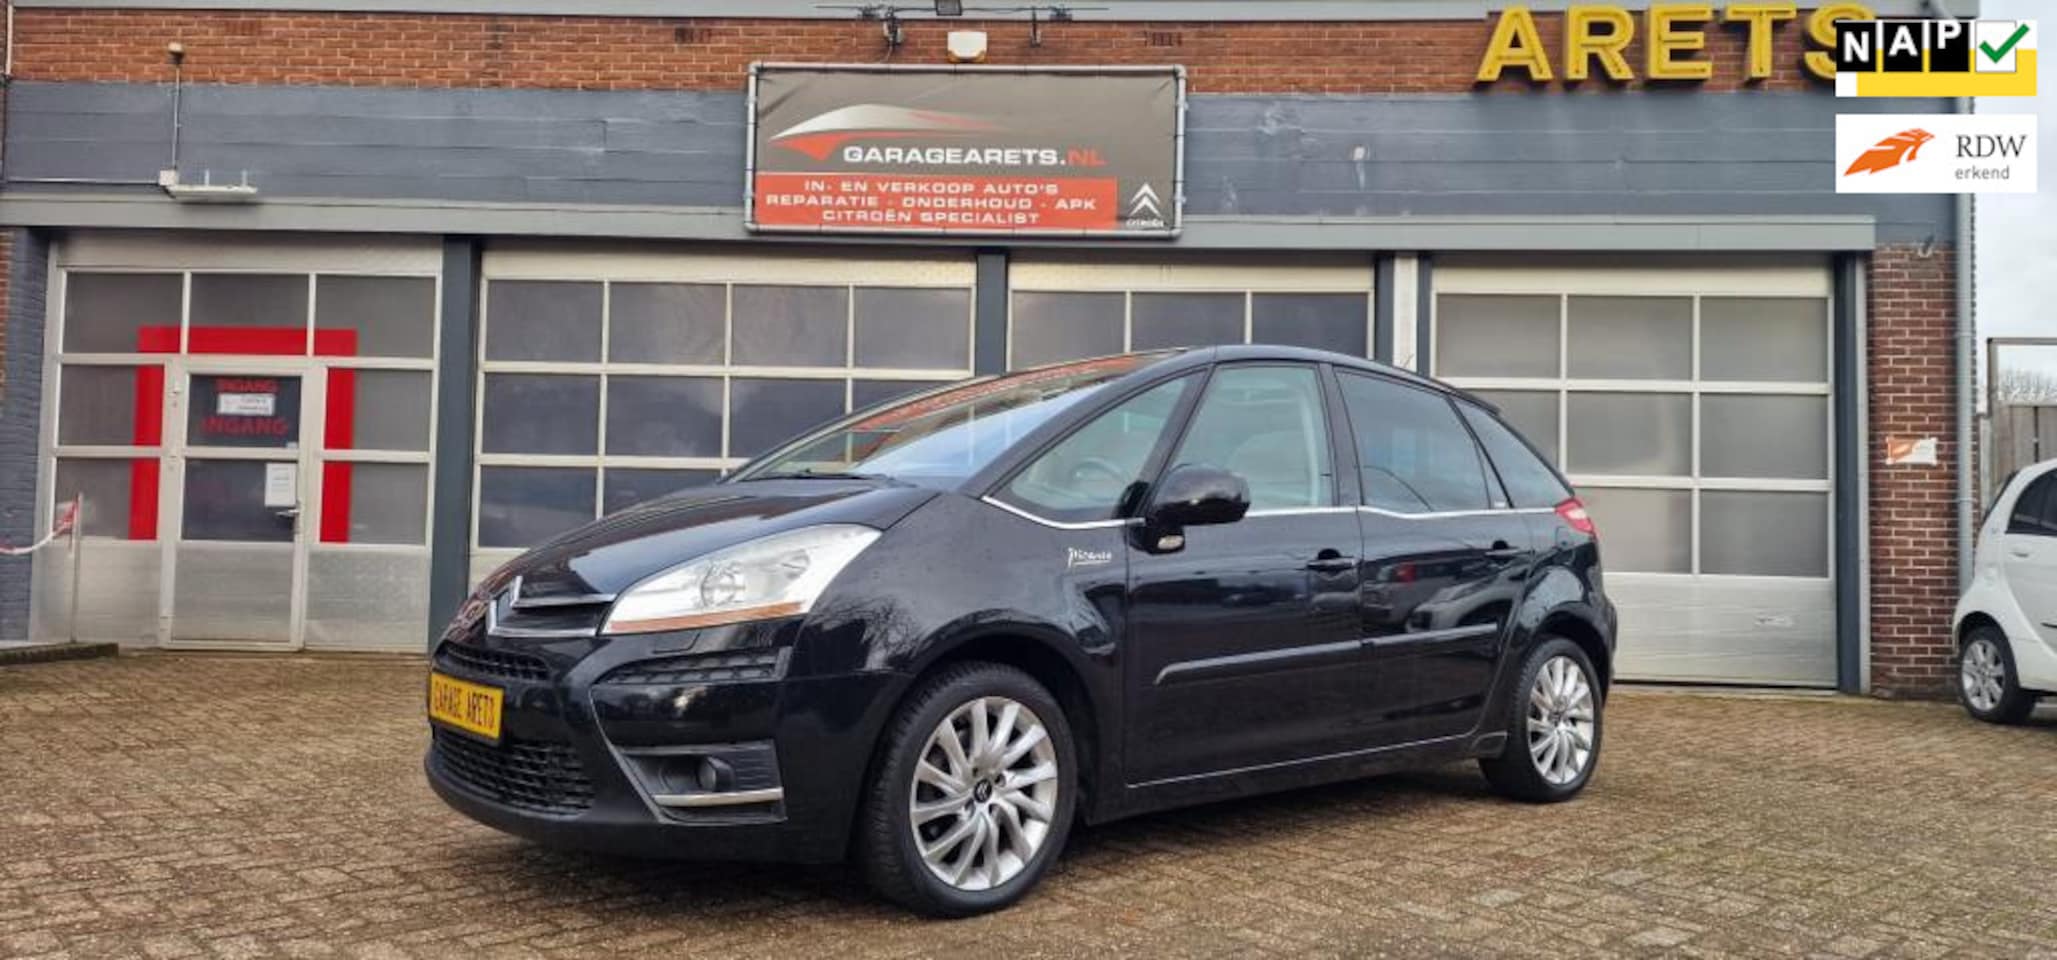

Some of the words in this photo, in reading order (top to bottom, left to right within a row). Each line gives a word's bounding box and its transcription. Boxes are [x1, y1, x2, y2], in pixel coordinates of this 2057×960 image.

[1476, 3, 1876, 81] ARETS
[843, 146, 1106, 167] GARAGEARETS.NL
[840, 182, 867, 192] EN
[877, 182, 975, 194] VERKOOP
[983, 183, 1059, 195] AUTO'S
[766, 194, 878, 206] REPARATIE
[902, 197, 1032, 209] ONDERHOUD
[1055, 199, 1096, 210] APK
[822, 209, 912, 222] CITROËN
[920, 212, 1040, 224] SPECIALIST
[202, 416, 288, 436] INGANG
[434, 681, 462, 718] GARAGE
[466, 691, 494, 730] ARETS
